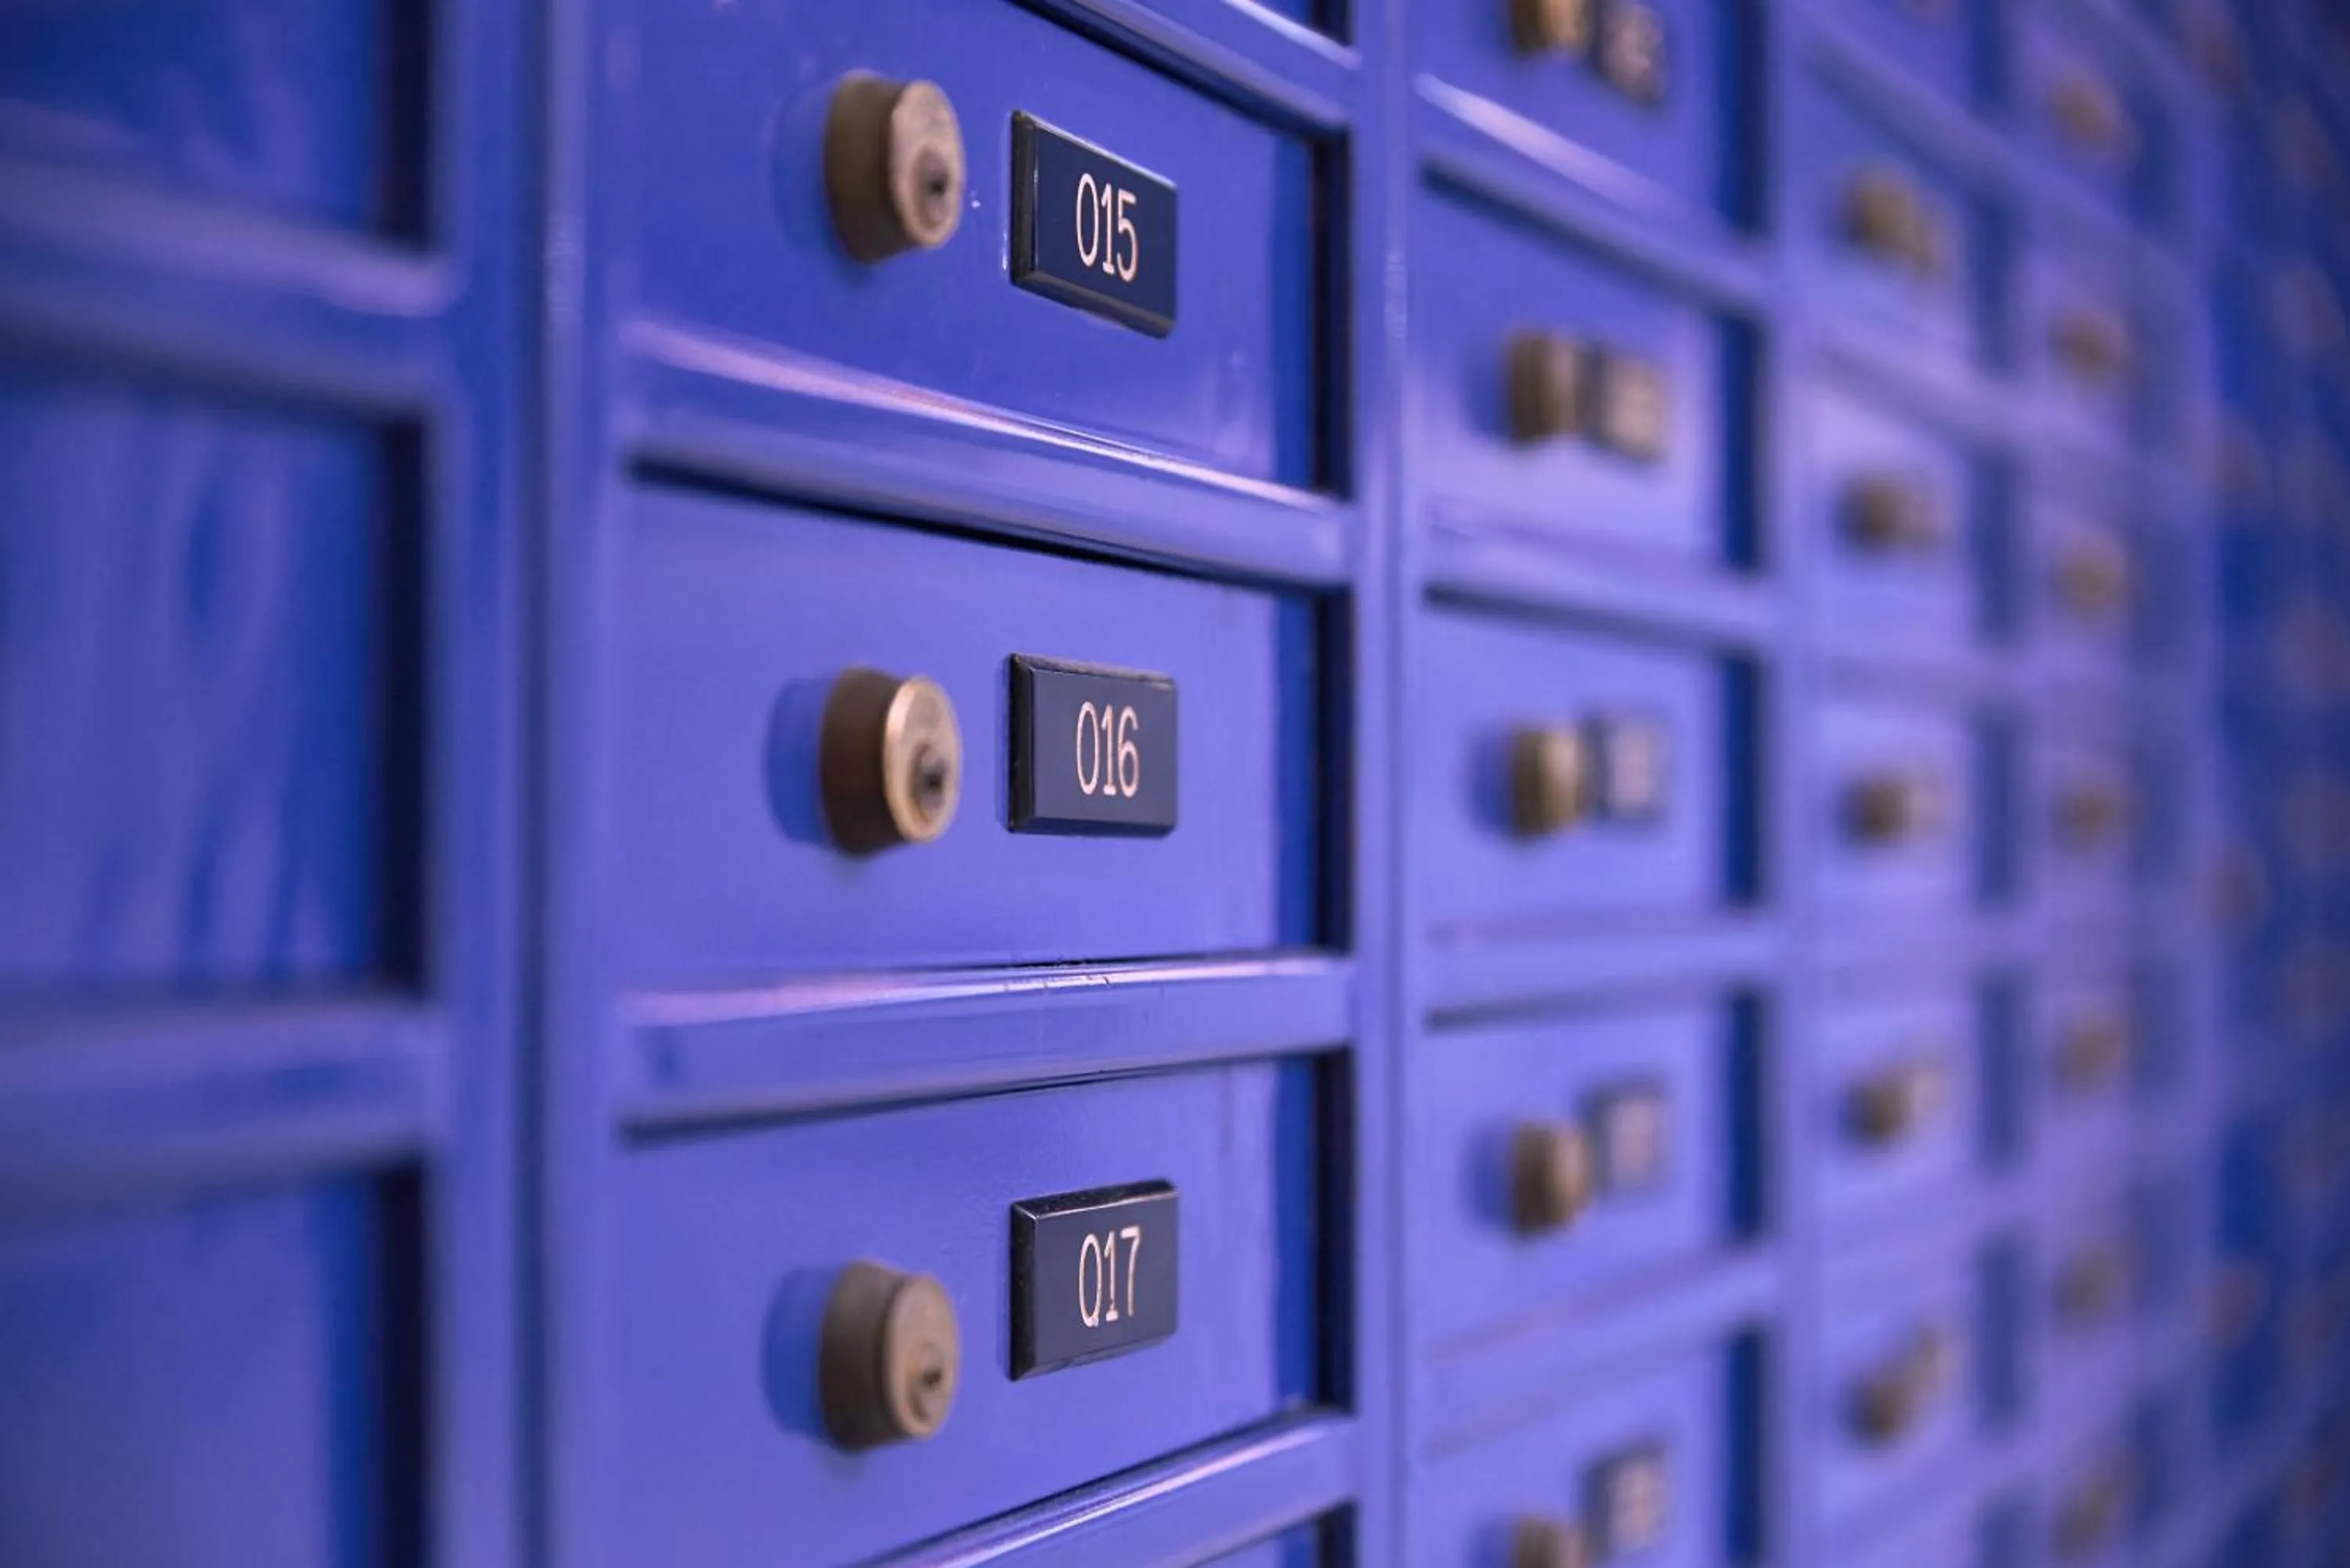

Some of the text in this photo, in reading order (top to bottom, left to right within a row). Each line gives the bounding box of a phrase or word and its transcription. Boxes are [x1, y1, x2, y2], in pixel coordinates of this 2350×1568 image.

[1076, 173, 1138, 282] 015
[1076, 702, 1139, 797] 016
[1079, 1226, 1141, 1328] 017
